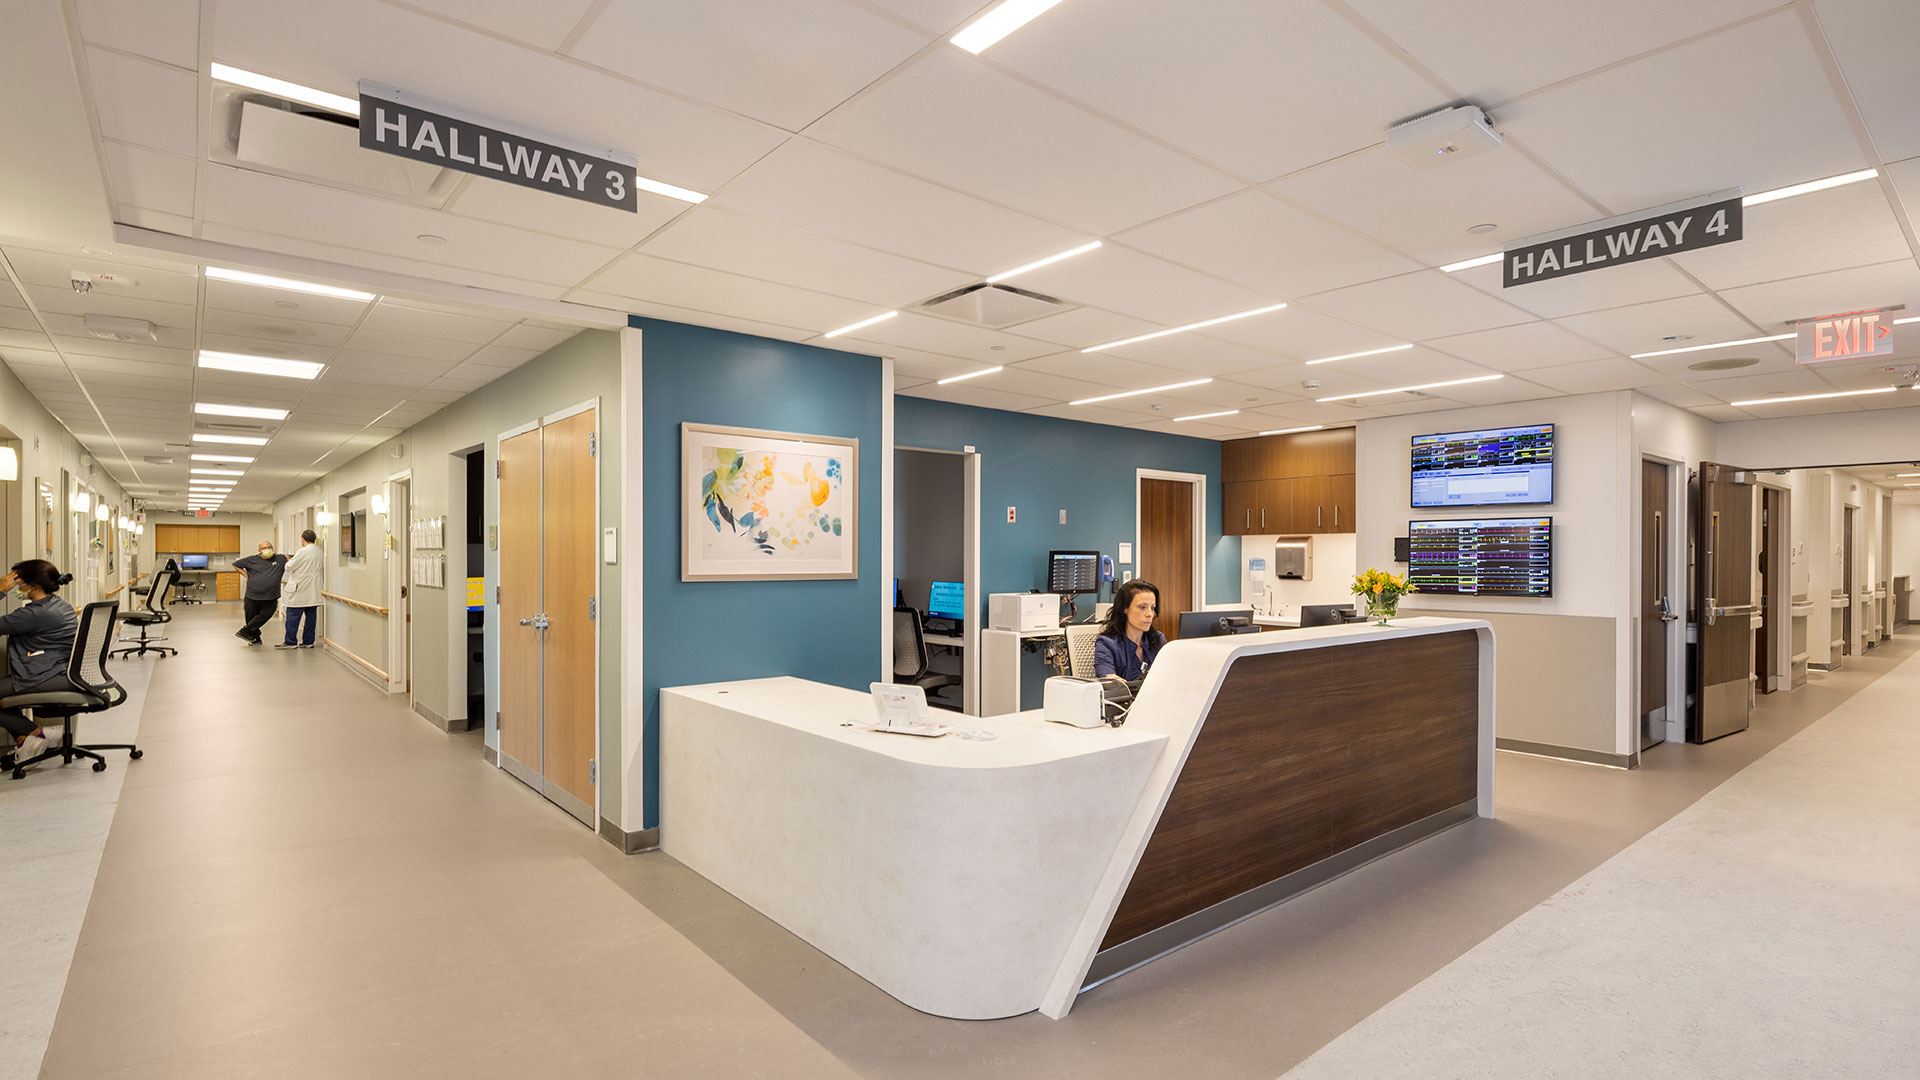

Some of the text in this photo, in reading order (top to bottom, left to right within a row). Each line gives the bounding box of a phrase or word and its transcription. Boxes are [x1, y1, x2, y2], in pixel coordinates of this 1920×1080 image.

[375, 107, 626, 201] HALLWAY 3
[1511, 209, 1729, 280] HALLWAY 4
[1814, 314, 1880, 359] EXIT
